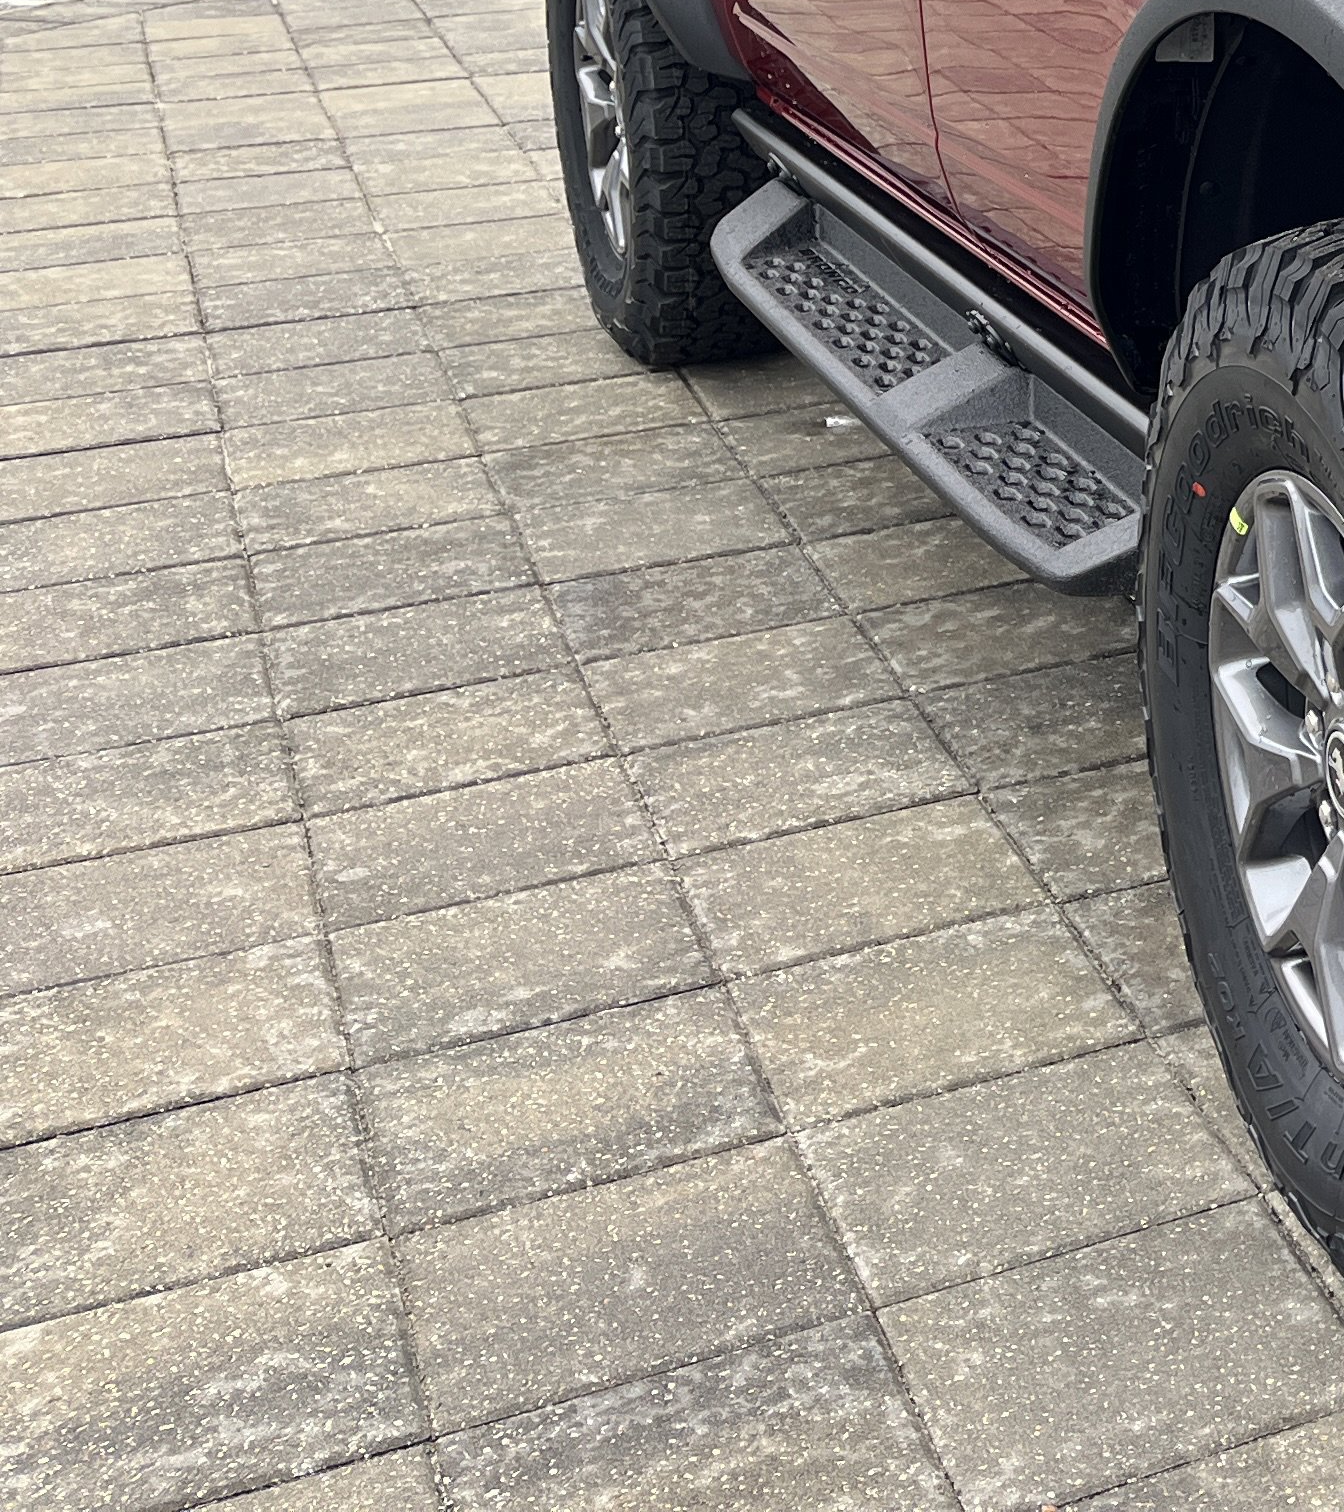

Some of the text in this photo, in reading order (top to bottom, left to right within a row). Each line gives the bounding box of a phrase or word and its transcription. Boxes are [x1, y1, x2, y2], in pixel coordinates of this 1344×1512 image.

[1156, 393, 1310, 687] BFGoodrich
[1206, 952, 1247, 1041] KO2
[1246, 1042, 1317, 1165] T/A
